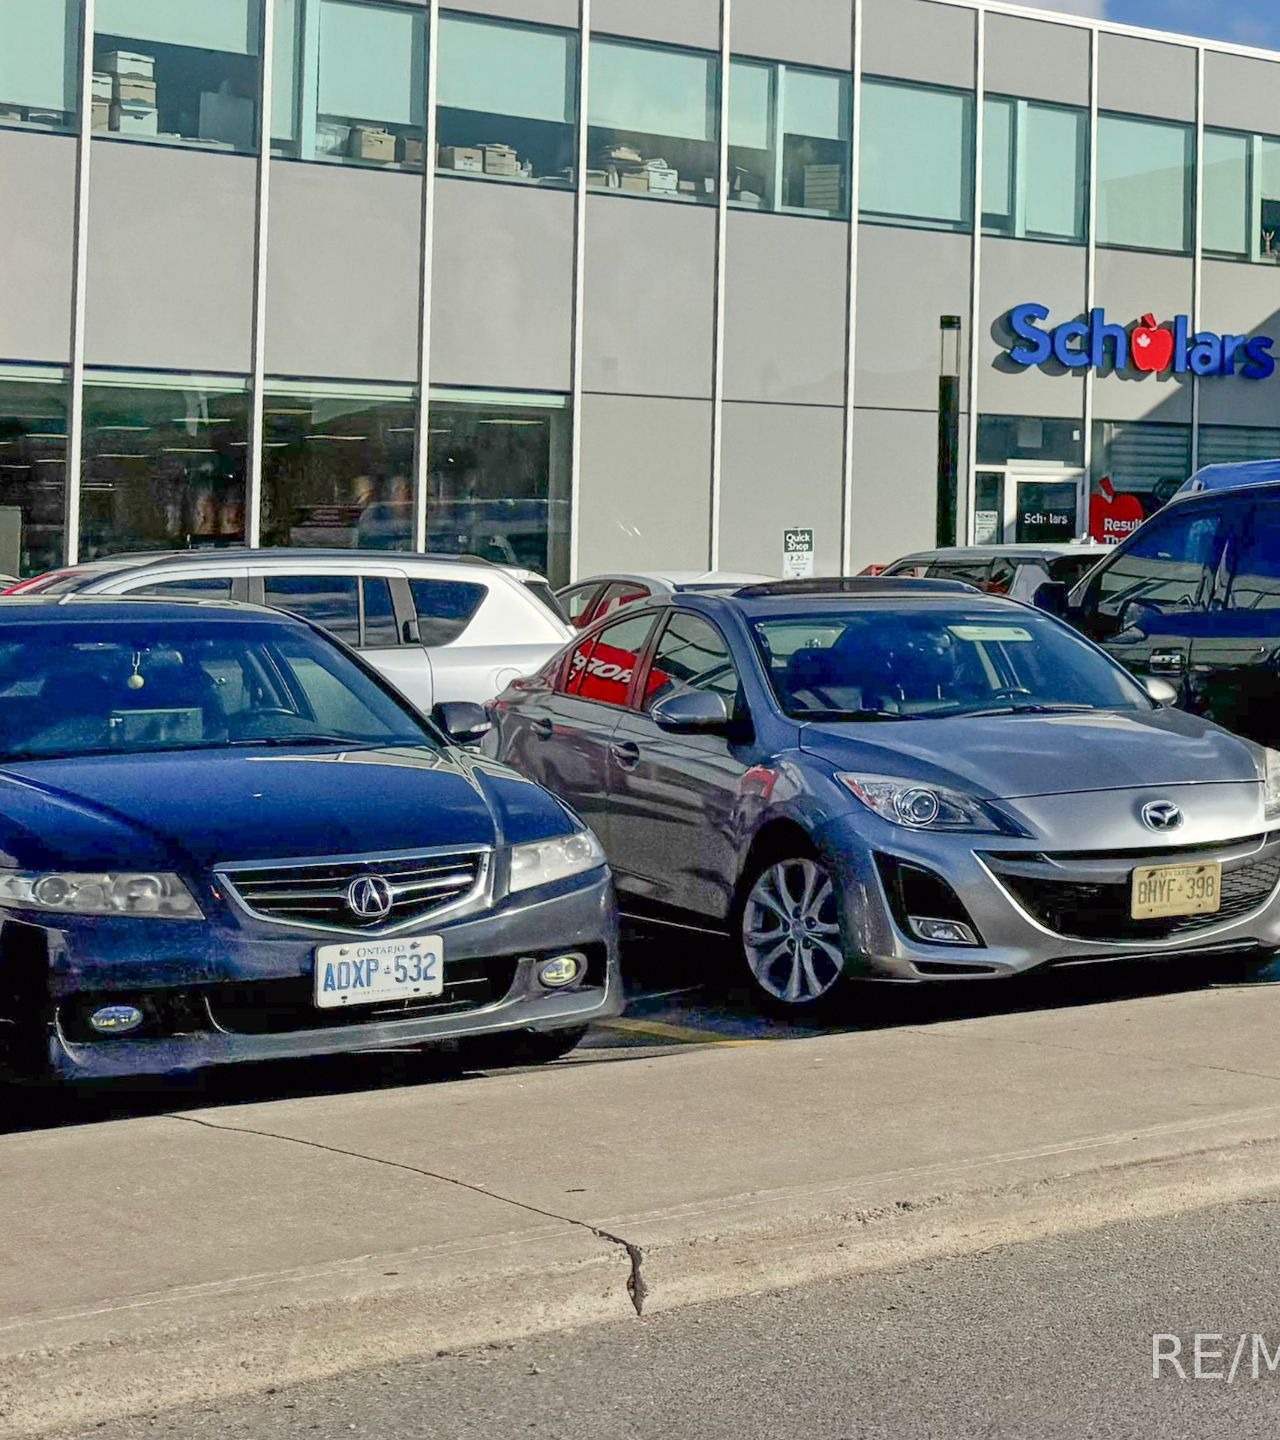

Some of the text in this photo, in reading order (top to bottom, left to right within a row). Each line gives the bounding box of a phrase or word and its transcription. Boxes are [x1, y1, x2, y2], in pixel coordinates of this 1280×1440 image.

[1023, 512, 1069, 525] Schlars
[785, 532, 811, 543] Quick
[787, 542, 810, 552] Shop
[1186, 875, 1215, 900] 398
[357, 944, 405, 958] ONTARIO
[394, 952, 437, 984] 532
